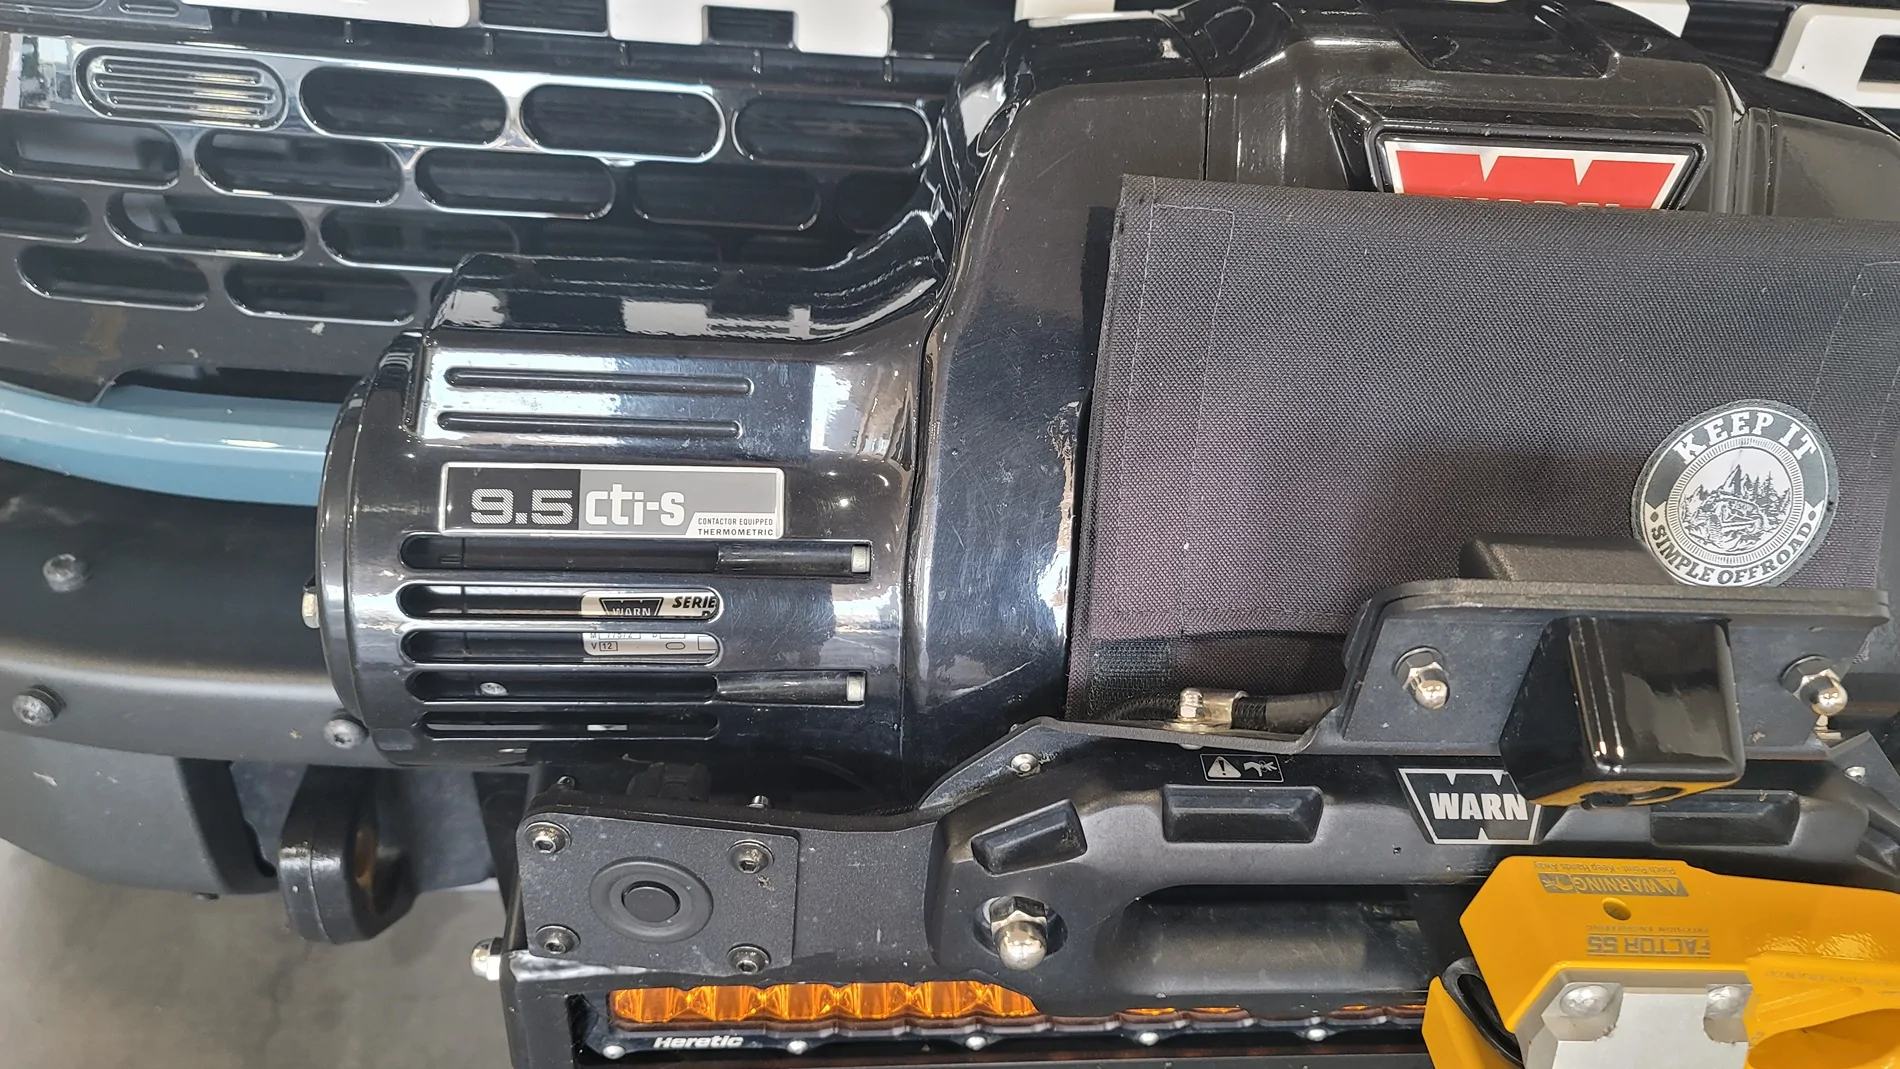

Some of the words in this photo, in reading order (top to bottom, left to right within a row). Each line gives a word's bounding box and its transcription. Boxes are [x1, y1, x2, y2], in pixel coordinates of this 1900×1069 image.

[1673, 411, 1775, 465] KEEP
[1778, 423, 1818, 461] IT
[471, 488, 573, 525] 9.5
[585, 484, 685, 526] cti-s
[739, 518, 773, 526] EQUIPPED
[1651, 524, 1715, 584] SIMPLE
[1717, 520, 1814, 585] OFFROAD
[1429, 792, 1529, 820] WARN
[1560, 862, 1589, 872] Hands
[1591, 862, 1614, 873] Keep
[1649, 865, 1676, 875] Pinch
[1572, 876, 1661, 894] WARNING
[1587, 936, 1618, 952] 55
[1624, 936, 1711, 955] FACTOR
[653, 1035, 744, 1049] Heretic
